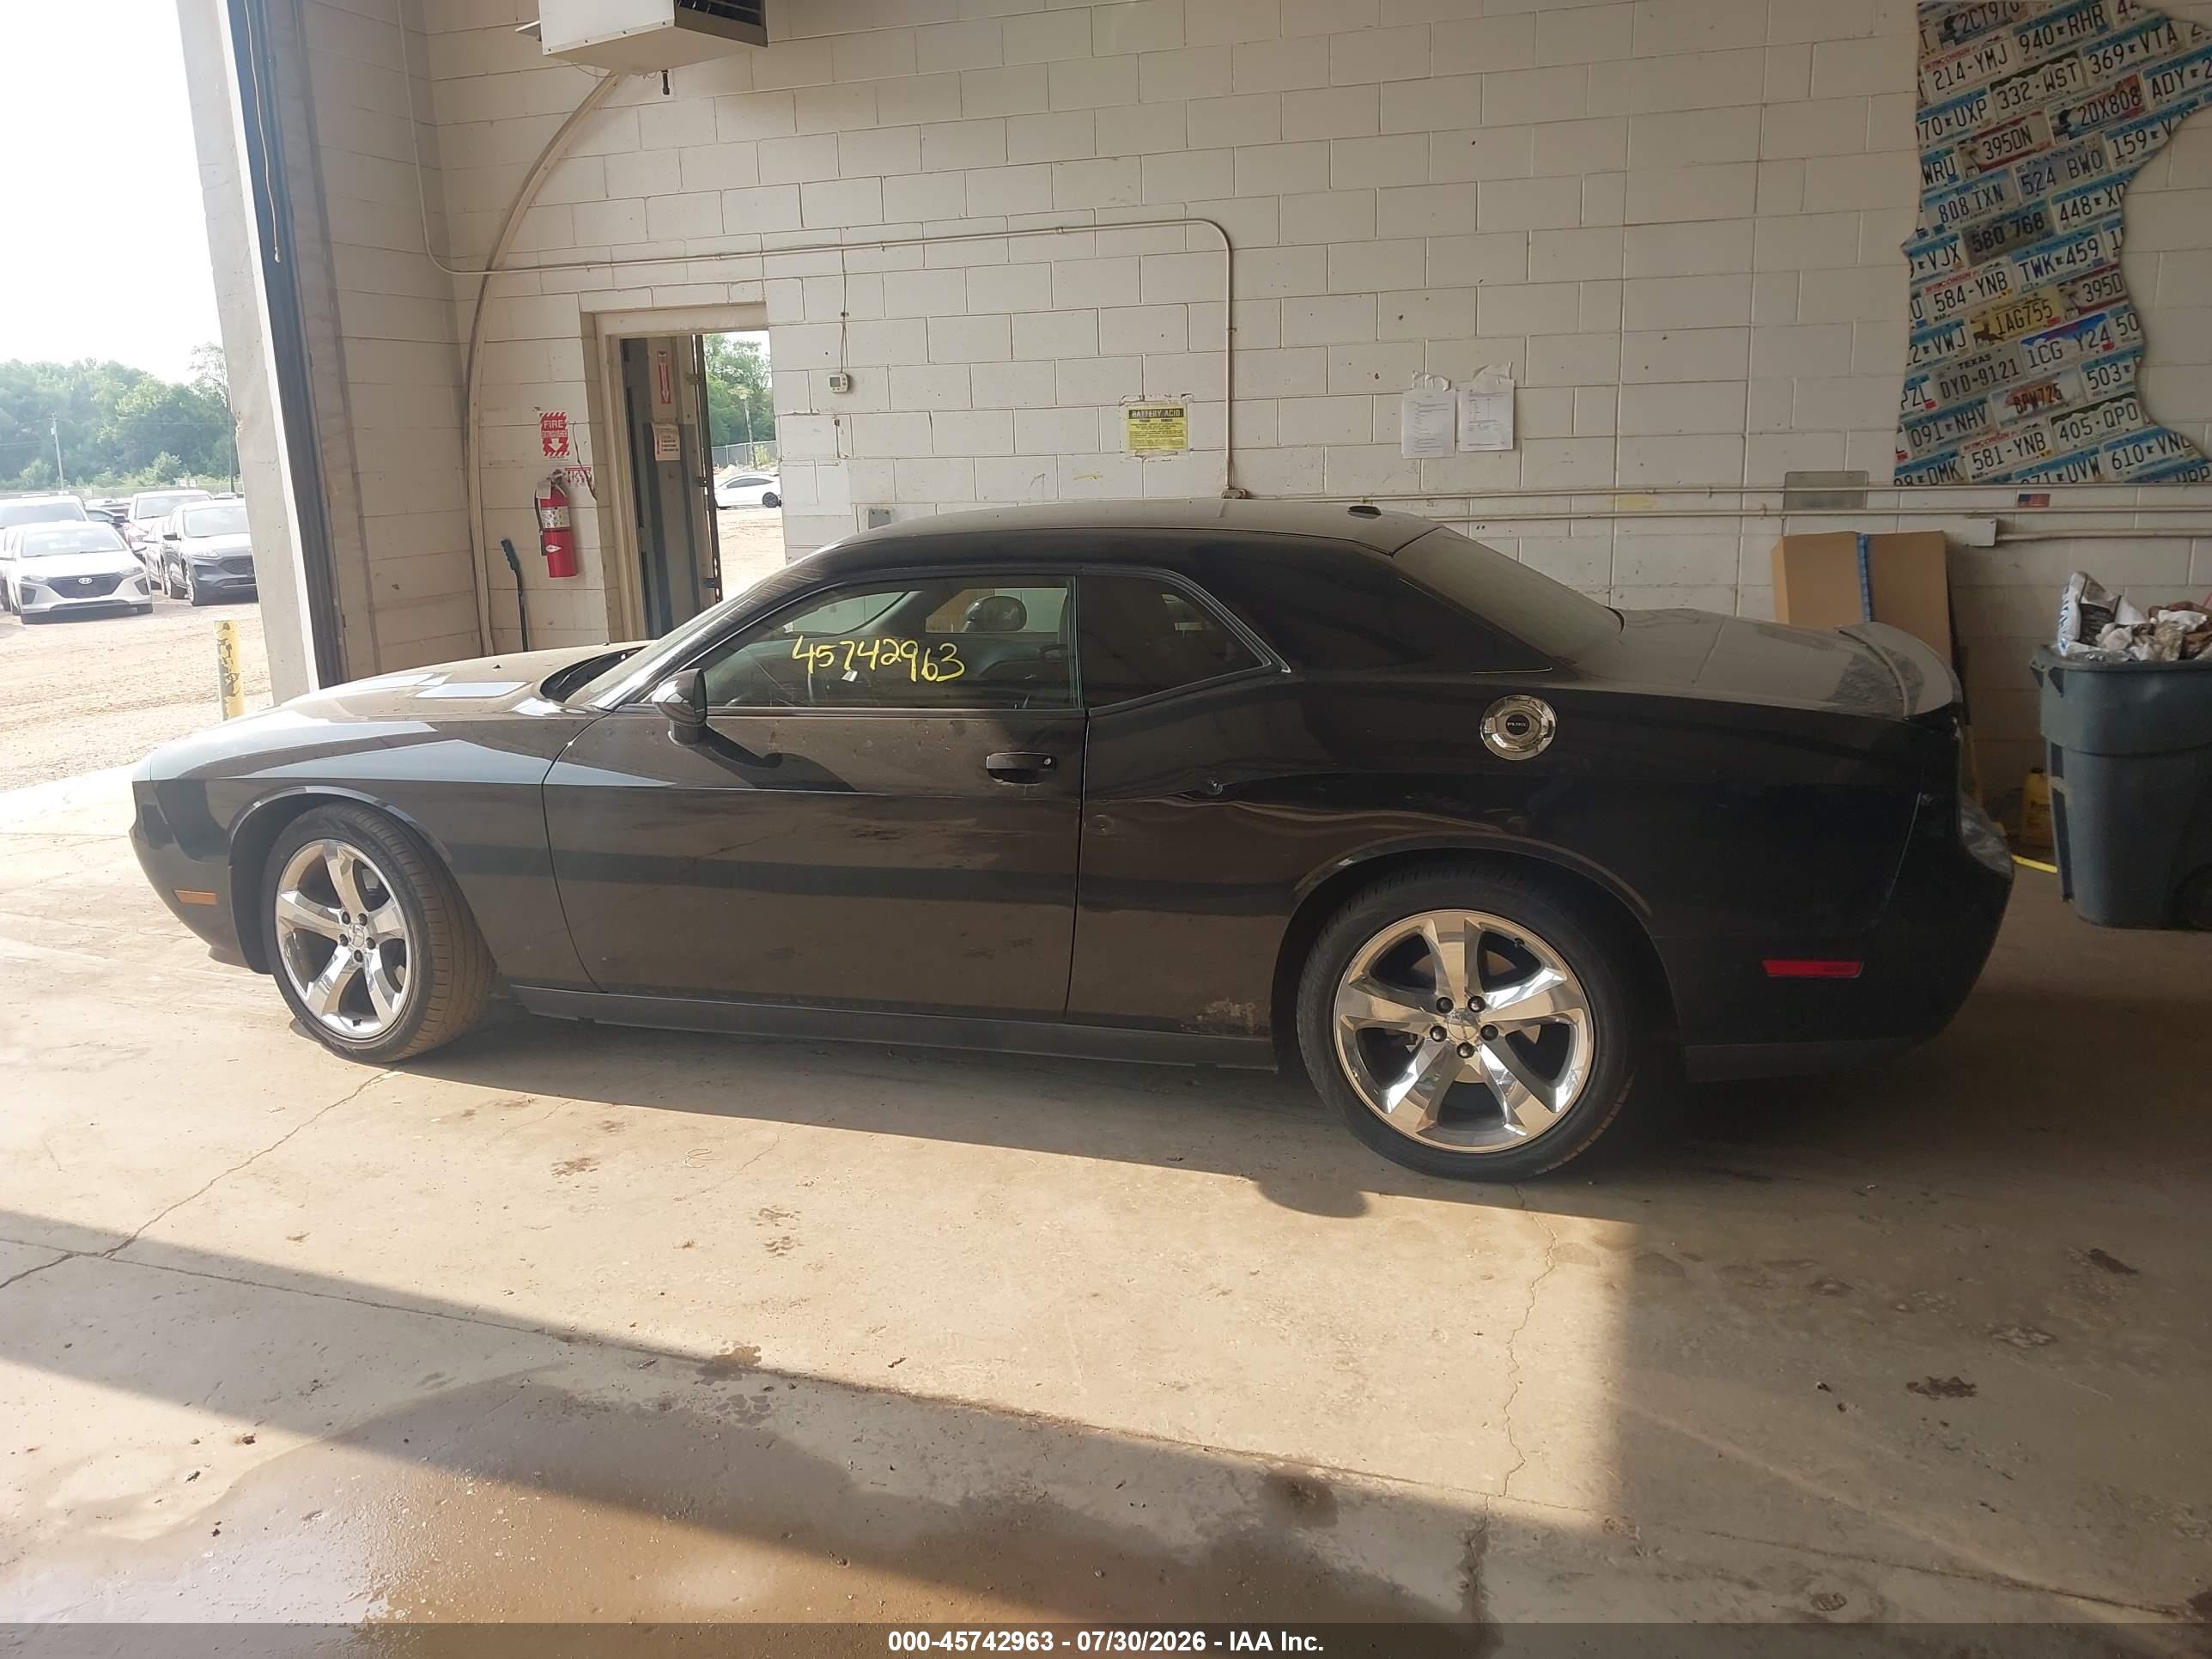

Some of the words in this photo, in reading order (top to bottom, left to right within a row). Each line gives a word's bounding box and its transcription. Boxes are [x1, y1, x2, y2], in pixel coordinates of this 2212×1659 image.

[2021, 167, 2057, 195] 524
[1938, 197, 1969, 223] 808
[1957, 353, 1992, 370] TEXAS
[543, 419, 564, 428] FIRE
[1164, 409, 1182, 418] ACID
[792, 635, 966, 683] 45742963
